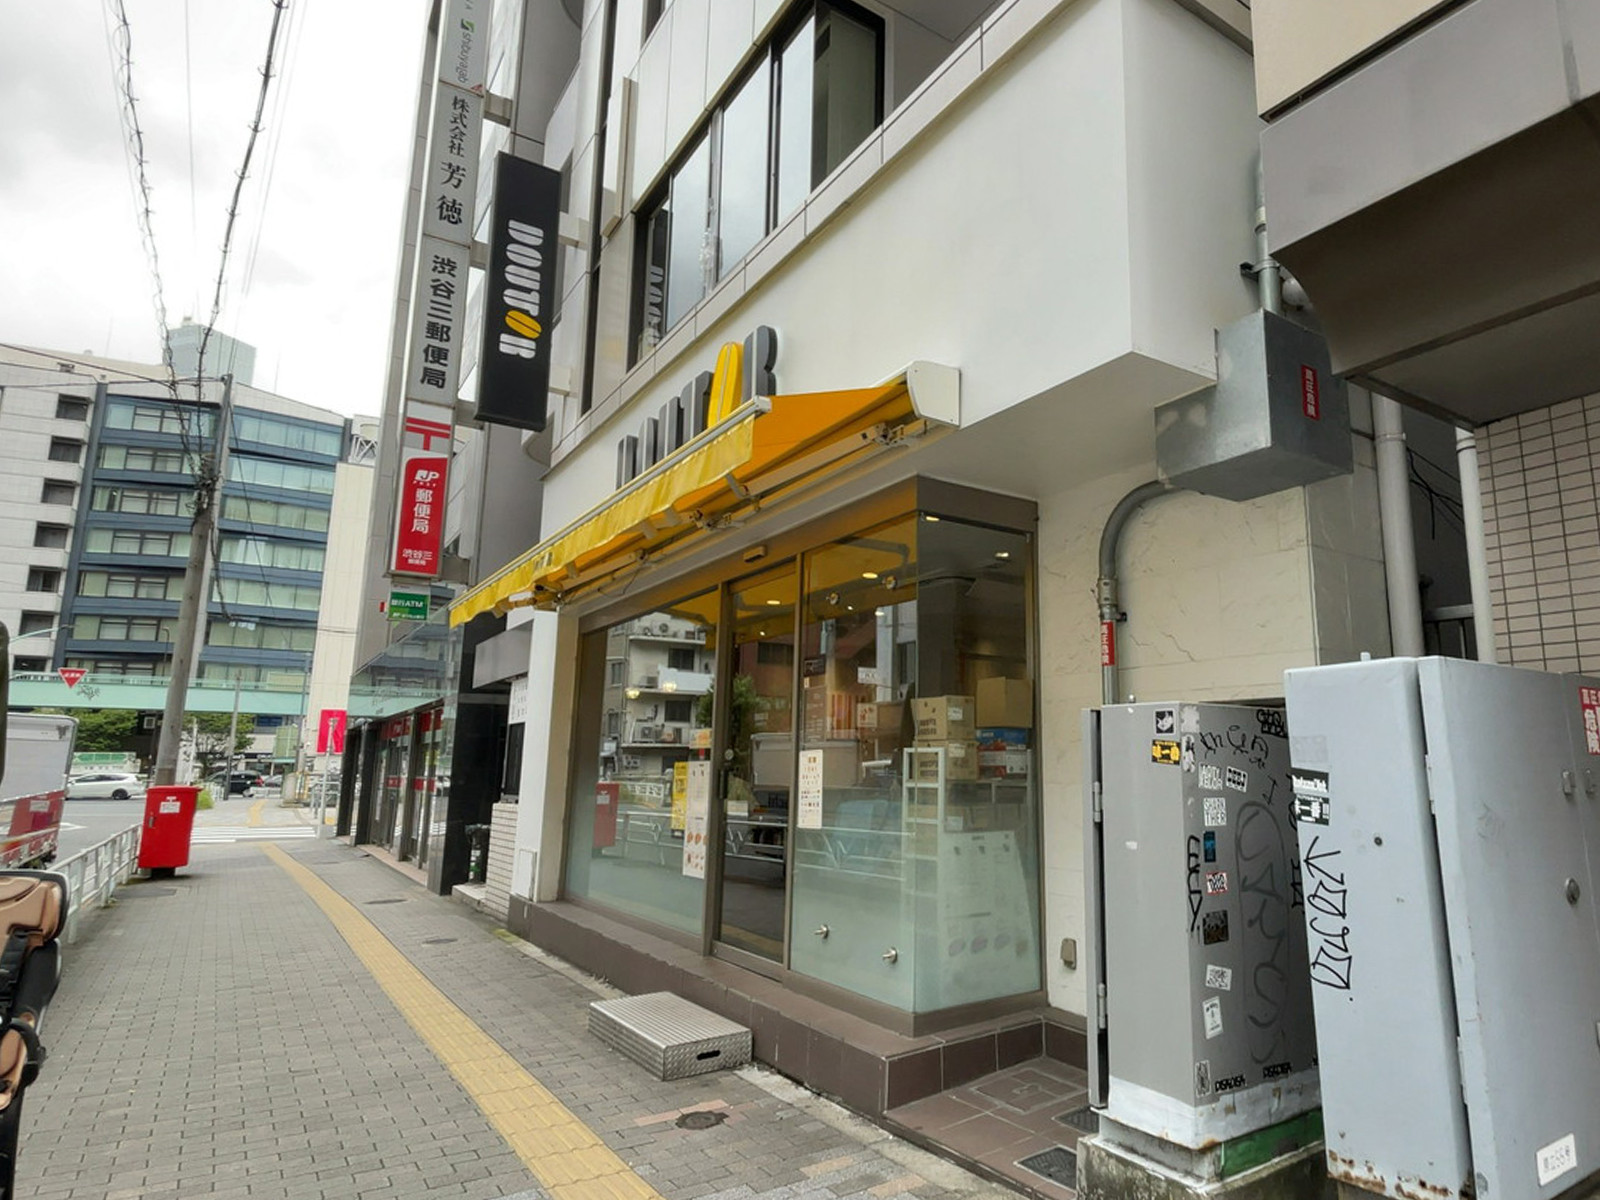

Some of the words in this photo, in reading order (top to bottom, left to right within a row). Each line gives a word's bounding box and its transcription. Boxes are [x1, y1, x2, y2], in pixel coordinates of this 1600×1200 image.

[447, 95, 470, 158] 株式会社
[420, 255, 458, 390] 渋谷三郵便局
[500, 219, 545, 359] DOUTOR
[411, 488, 433, 534] 郵便局
